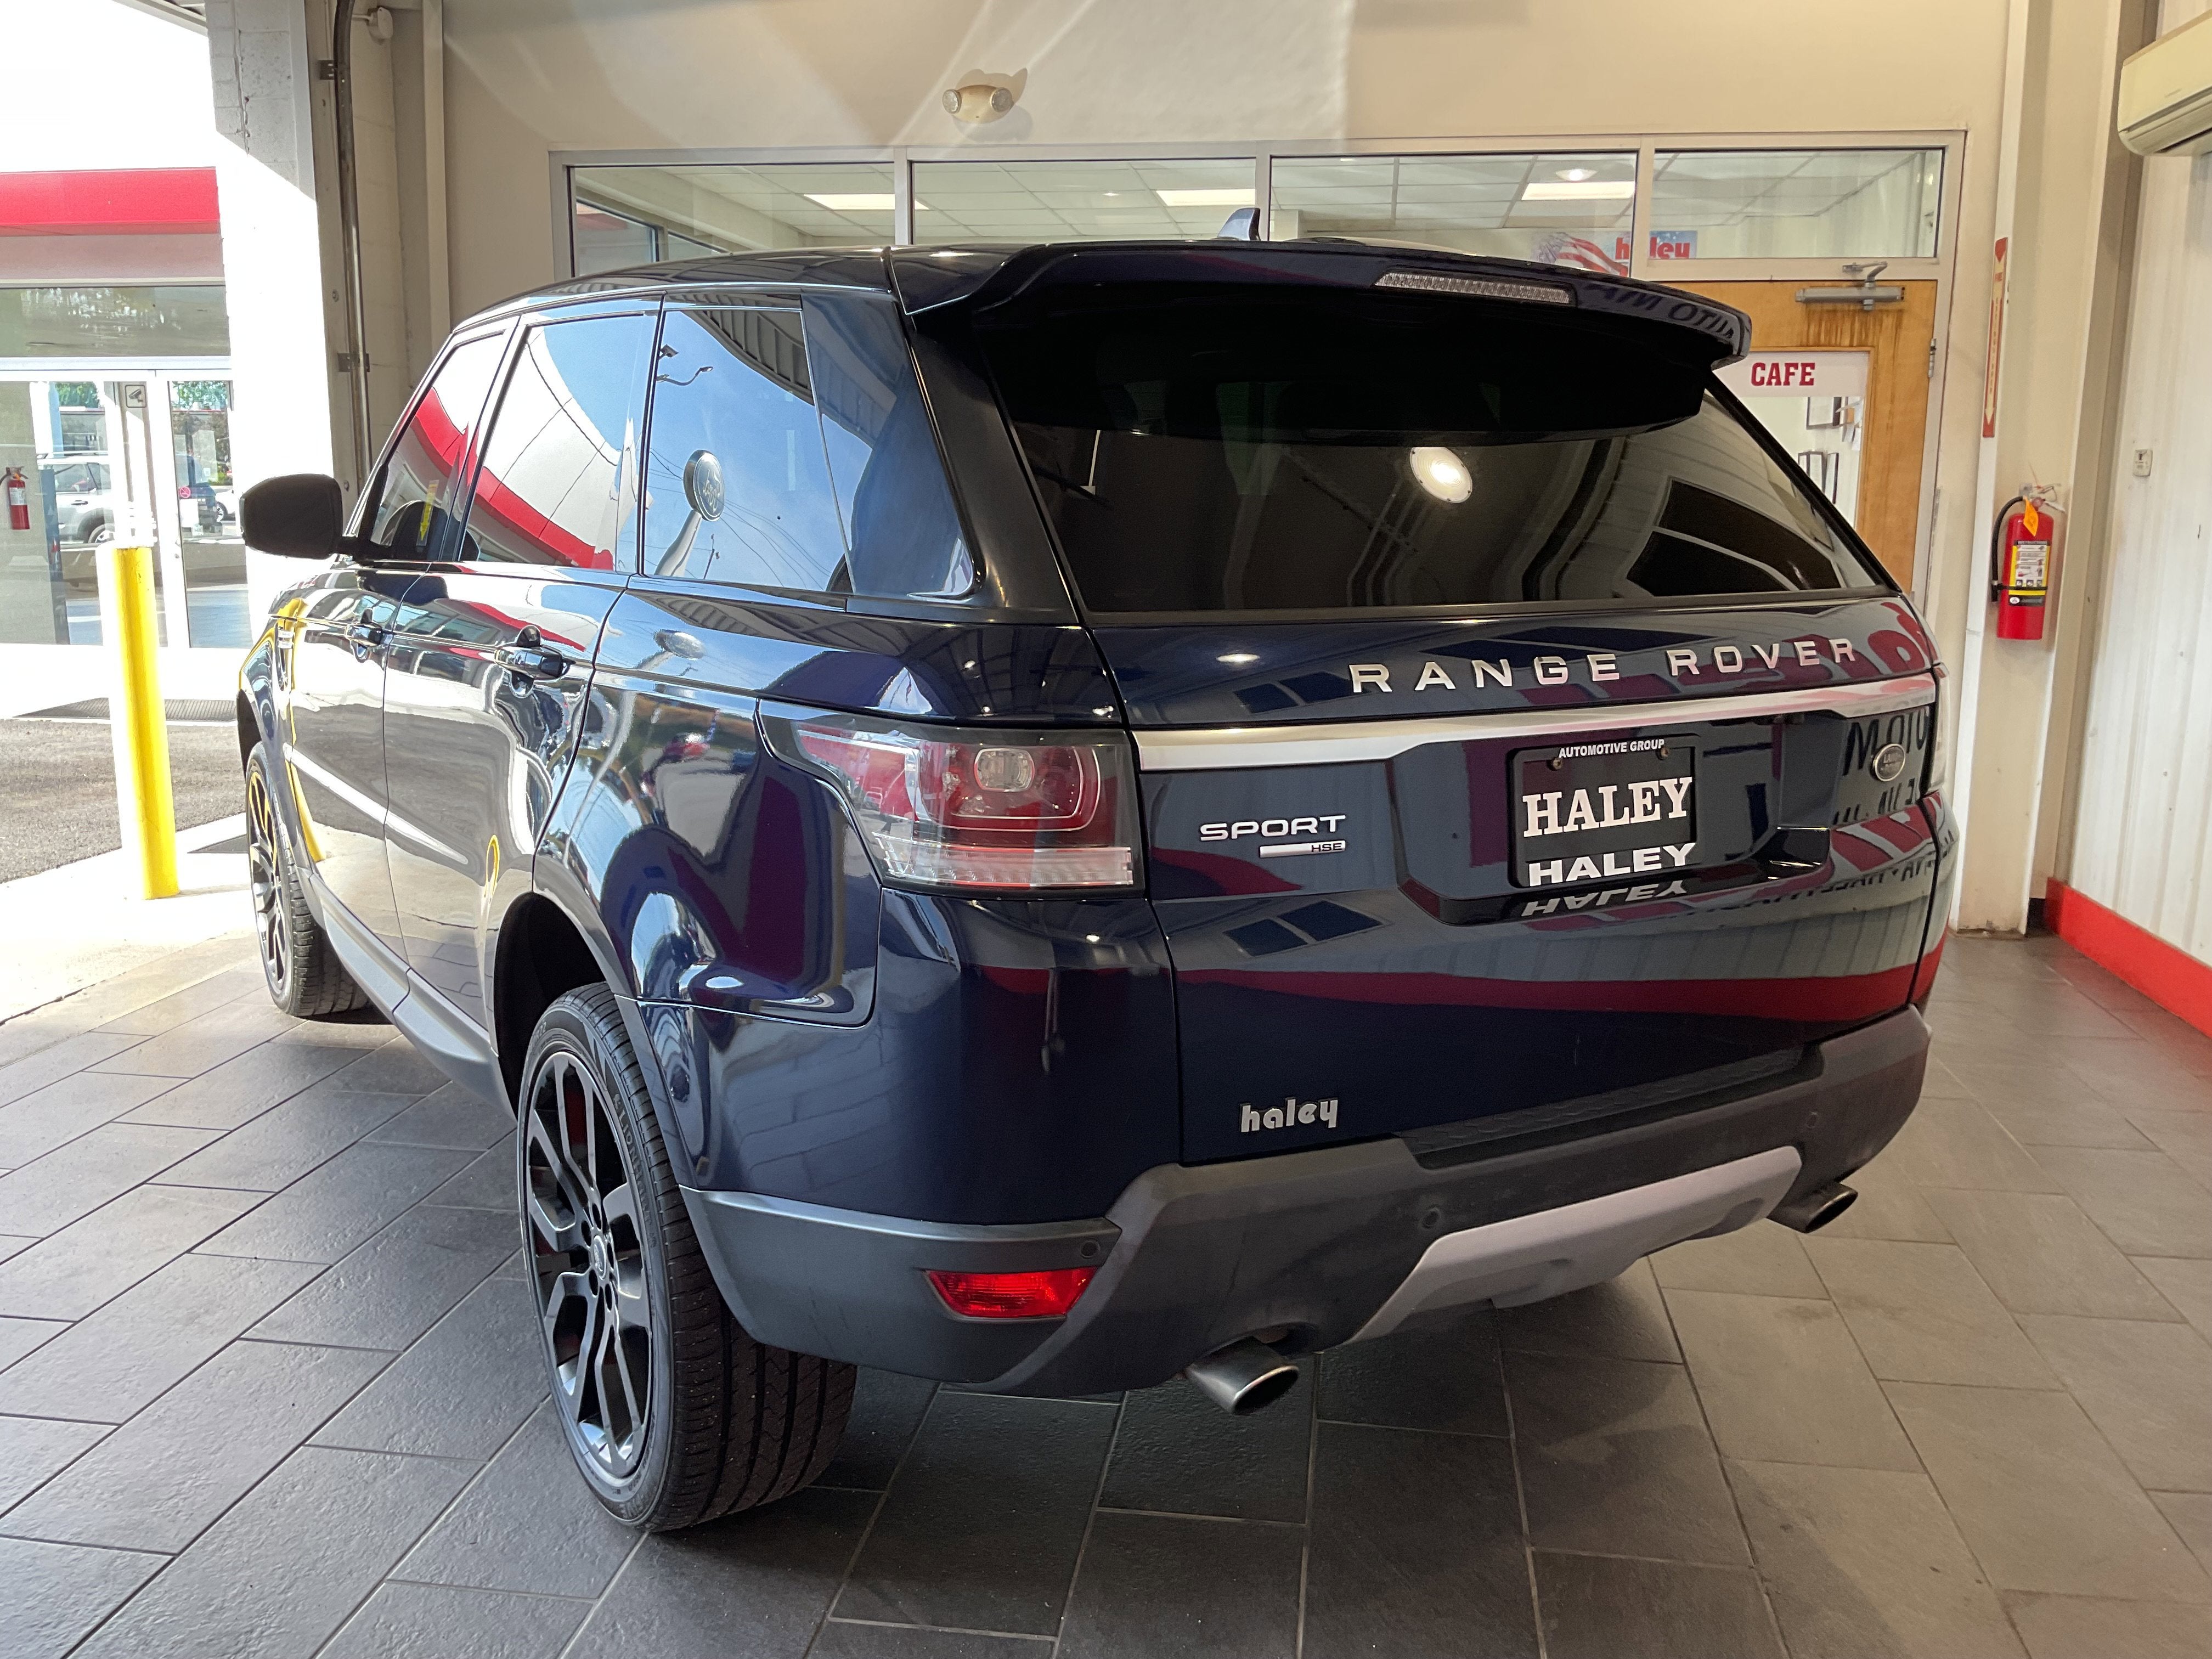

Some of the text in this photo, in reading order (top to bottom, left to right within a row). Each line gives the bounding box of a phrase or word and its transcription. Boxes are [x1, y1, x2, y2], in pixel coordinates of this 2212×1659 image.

[1615, 236, 1690, 259] hley
[1751, 362, 1816, 386] CAFE
[1349, 637, 1856, 693] RANGE ROVER
[1558, 739, 1665, 758] AUTOMOTIVE GROUP
[1522, 776, 1693, 838] HALEY
[1200, 815, 1346, 841] SPORT
[1311, 842, 1343, 853] HSE
[1528, 843, 1696, 887] HALEY
[1240, 1098, 1339, 1132] haley
